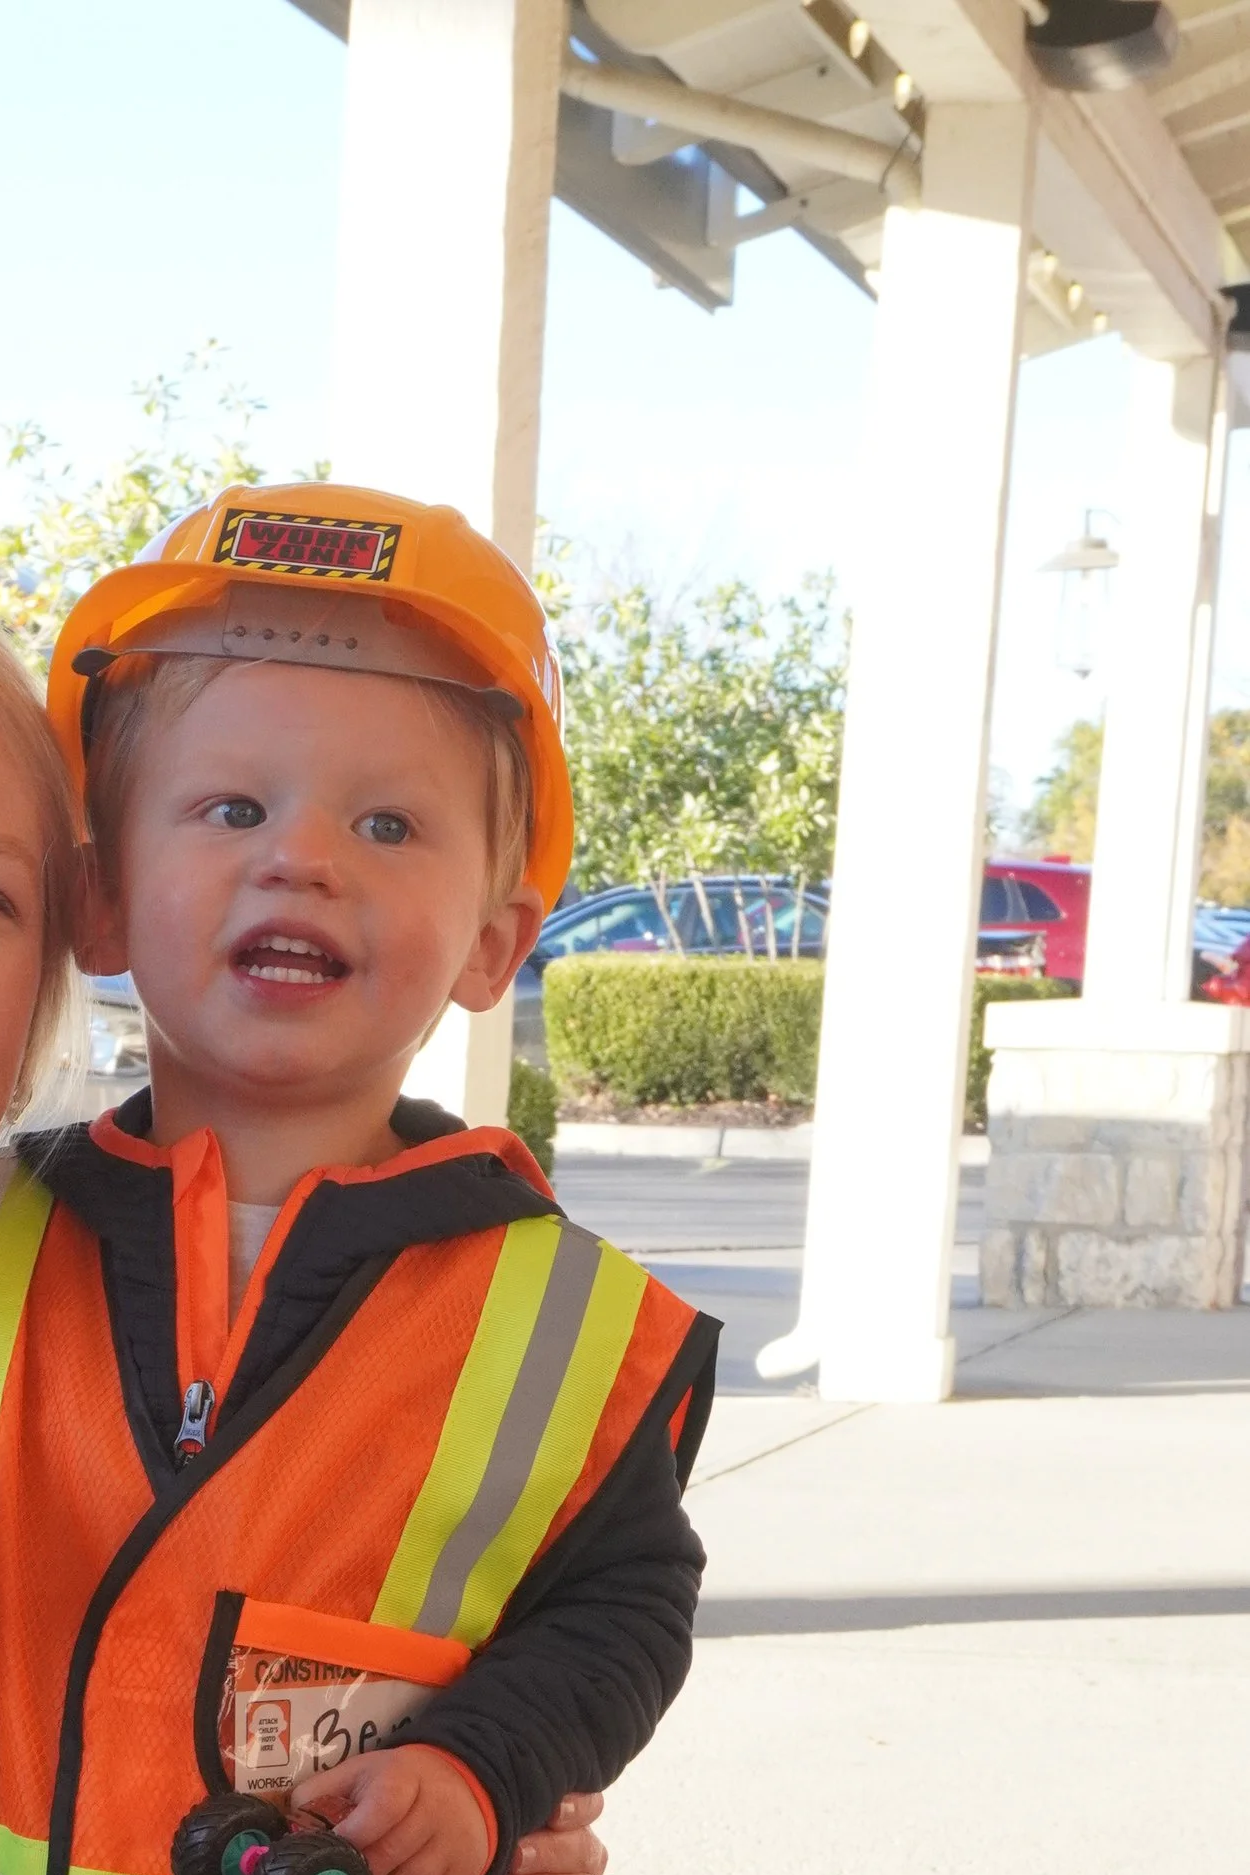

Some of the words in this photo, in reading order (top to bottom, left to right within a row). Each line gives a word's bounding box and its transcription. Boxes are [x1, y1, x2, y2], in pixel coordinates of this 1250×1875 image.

[249, 523, 370, 551] WORK
[254, 541, 357, 566] ZONE
[258, 1735, 276, 1743] HOTO
